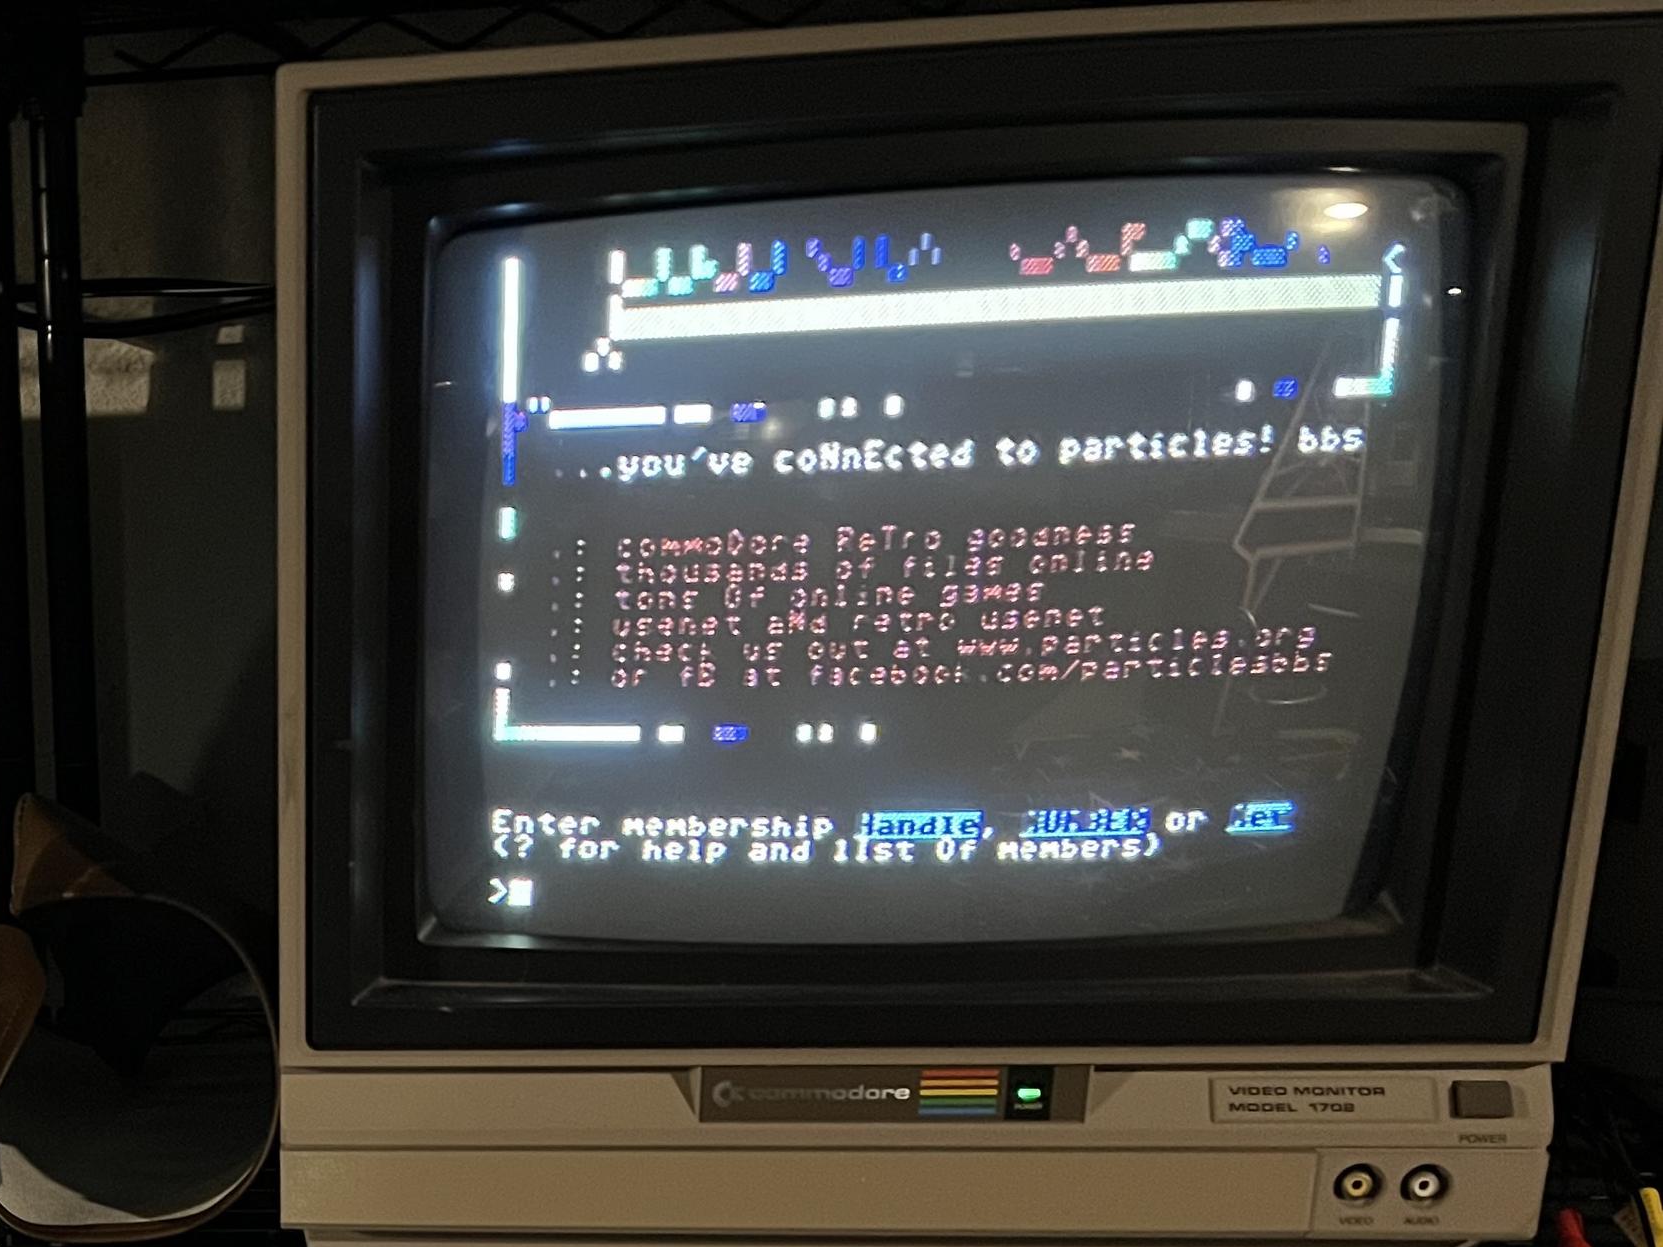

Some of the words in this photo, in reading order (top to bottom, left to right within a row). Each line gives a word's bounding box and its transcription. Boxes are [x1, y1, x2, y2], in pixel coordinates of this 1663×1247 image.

[995, 436, 1040, 467] to
[1057, 423, 1274, 466] particles!
[1298, 425, 1366, 454] bbs
[967, 523, 1136, 553] goodness
[615, 560, 810, 585] thousands
[835, 556, 876, 581] of
[902, 554, 1004, 579] files
[1028, 550, 1155, 576] online
[615, 589, 699, 610] tons
[790, 584, 915, 608] online
[938, 582, 1045, 608] games
[612, 614, 741, 637] usenet
[852, 611, 955, 633] retro
[980, 606, 1105, 632] usenet
[742, 640, 783, 662] us
[807, 639, 869, 660] out
[892, 635, 931, 659] at
[956, 626, 1317, 658] www.particles.org
[610, 667, 646, 689] or
[742, 666, 781, 688] at
[491, 807, 601, 836] Enter
[621, 813, 834, 841] membership
[1165, 809, 1208, 834] or
[558, 836, 620, 860] for
[641, 838, 728, 864] help
[748, 838, 813, 864] and
[996, 832, 1161, 862] members)
[1228, 1085, 1288, 1097] VIDEO
[1293, 1085, 1386, 1098] MONITOR
[1228, 1102, 1298, 1113] MODEL
[1308, 1102, 1356, 1113] 1702
[1458, 1132, 1508, 1145] POWER
[1339, 1215, 1374, 1227] VIDEO
[1403, 1215, 1439, 1227] AUDIO
